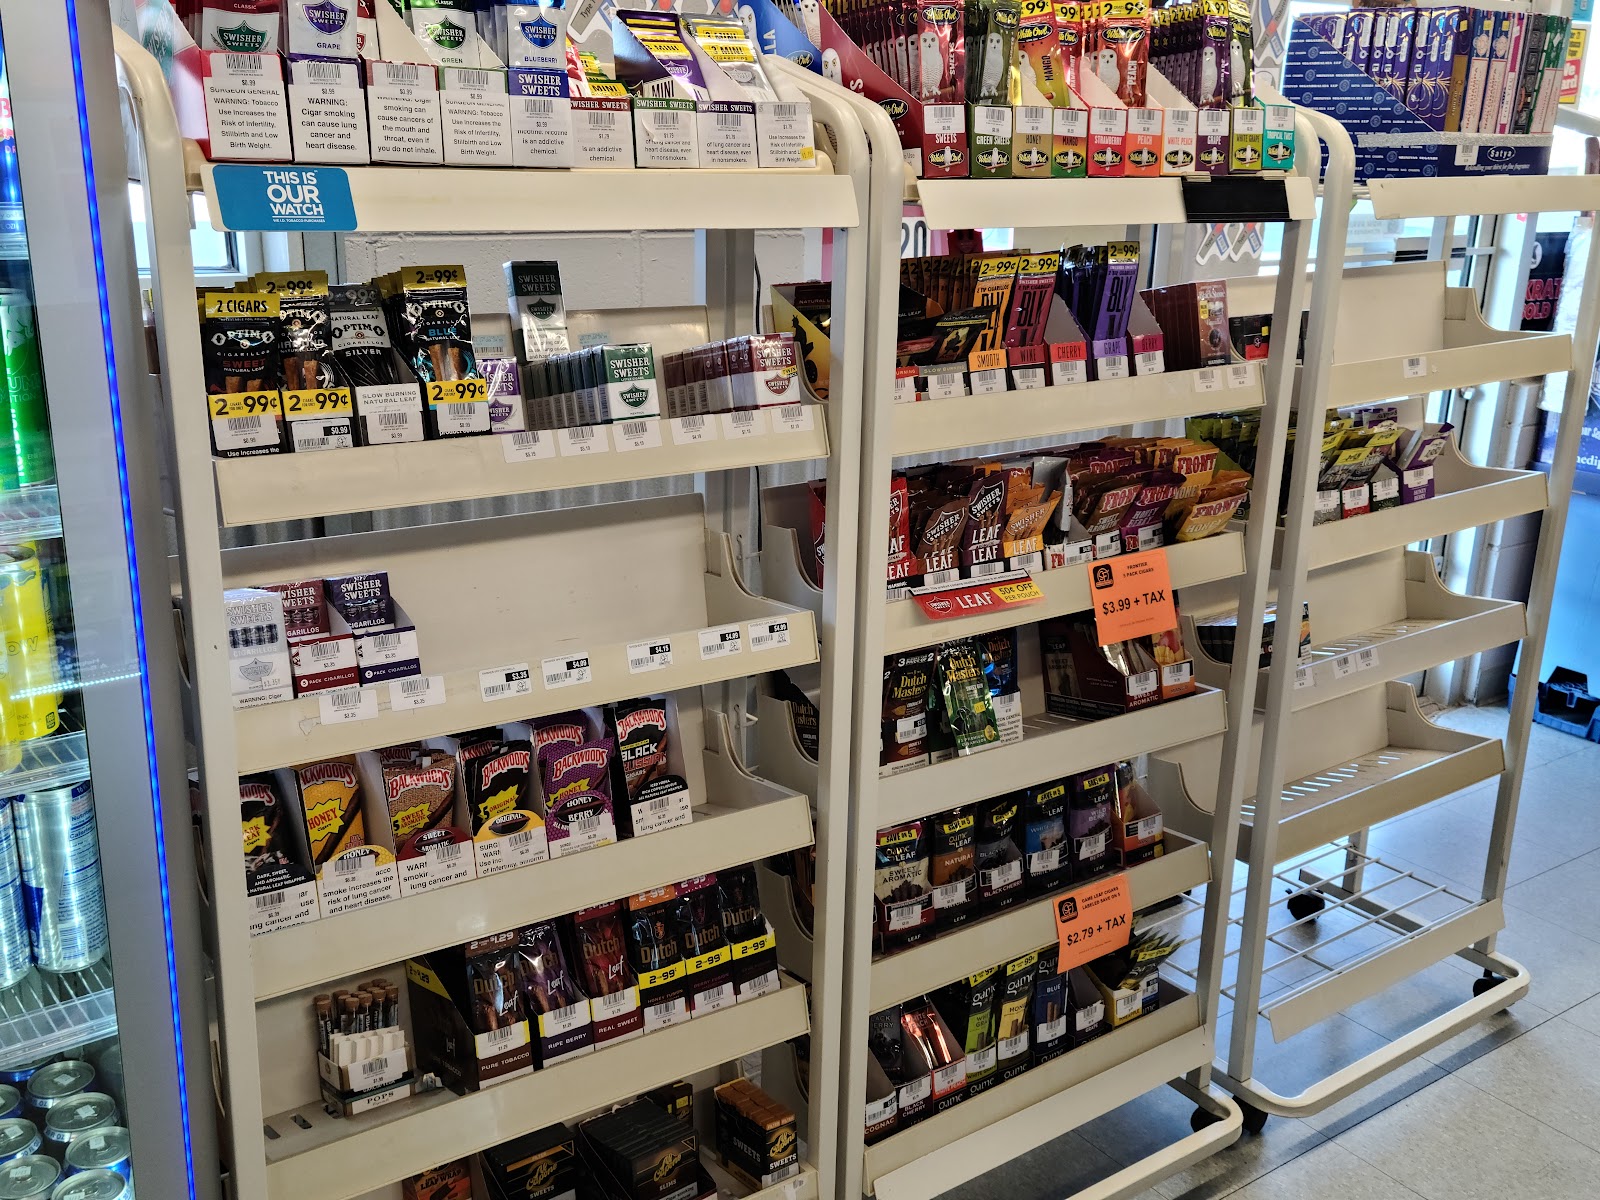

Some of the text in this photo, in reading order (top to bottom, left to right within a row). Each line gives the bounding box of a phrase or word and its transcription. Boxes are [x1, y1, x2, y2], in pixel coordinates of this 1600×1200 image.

[308, 11, 345, 20] SWISHER
[430, 27, 464, 36] SWISHER
[524, 25, 557, 36] SWISHER
[528, 32, 555, 40] SWEETS
[223, 32, 262, 42] SWISHER
[316, 42, 341, 50] GRAPE
[524, 55, 558, 63] BLUEBERRY
[1044, 56, 1053, 81] MANGO
[1128, 60, 1137, 85] PEACH
[518, 74, 561, 87] SWISHER
[522, 84, 561, 96] SWEETS
[591, 84, 618, 92] MINI
[651, 80, 674, 98] MINI
[214, 98, 249, 106] WARNING:
[308, 98, 348, 107] WARNING:
[636, 99, 694, 109] SWISHER SWEETS
[699, 103, 753, 112] SWISHER SWEETS
[301, 109, 355, 119] Cigar smoking
[341, 121, 357, 130] lung
[935, 133, 957, 143] SWEETS
[1026, 135, 1042, 144] HONEY
[1063, 137, 1078, 146] MANGO
[1095, 135, 1122, 145] STRAWBERRY
[1138, 135, 1152, 145] PEACH
[327, 143, 357, 151] disease.
[1490, 147, 1512, 158] Satya
[263, 171, 317, 185] THIS IS
[267, 185, 319, 203] OUR
[270, 203, 324, 216] WATCH
[518, 274, 556, 284] SWISHER
[521, 282, 556, 292] SWEETS
[217, 300, 268, 312] 2 CIGARS
[332, 323, 385, 338] OPTIMO
[429, 327, 457, 336] BLUE
[211, 330, 275, 345] OPTIMO
[1104, 341, 1121, 354] GRAPE
[1142, 339, 1158, 350] BERRY
[345, 348, 382, 357] SILVER
[756, 347, 792, 359] SWISHER
[1058, 344, 1081, 359] CHERRY
[223, 359, 266, 368] SWEET
[610, 357, 650, 368] SWISHER
[760, 356, 792, 367] SWEETS
[977, 354, 1000, 368] SMOOTH
[614, 366, 649, 377] SWEETS
[215, 395, 277, 416] 2 99¢
[289, 392, 349, 412] 2 99¢
[364, 397, 397, 405] NATURAL
[331, 426, 348, 434] $0.99
[972, 488, 1001, 514] SWISHER
[926, 513, 960, 538] SWISHER
[972, 524, 1001, 544] LEAF
[1013, 538, 1037, 554] LEAF
[973, 546, 998, 563] LEAF
[926, 554, 953, 573] LEAF
[1127, 562, 1147, 570] FRONTIER
[341, 580, 382, 592] SWISHER
[999, 583, 1033, 595] 50¢ OFF
[344, 589, 381, 601] SWEETS
[956, 591, 993, 609] LEAF
[1018, 591, 1039, 599] POUCH
[1103, 598, 1130, 616] $3.99
[1143, 590, 1165, 605] TAX
[226, 603, 273, 616] SWISHER
[388, 664, 417, 674] CIGARILLOS
[949, 657, 976, 670] Dutch
[324, 673, 355, 682] CIGARILLOS
[512, 670, 528, 680] $3.35
[946, 667, 980, 682] Masters
[901, 675, 927, 688] Dutch
[892, 684, 927, 698] Masters
[1129, 695, 1159, 706] AROMATIC
[618, 708, 666, 740] BACKWOODS
[481, 751, 530, 790] BACKWOODS
[553, 748, 608, 781] BACKWOODS
[389, 769, 451, 798] BACKWOODS
[559, 785, 582, 799] HONEY
[566, 797, 593, 808] HONEY
[1094, 793, 1109, 804] LEAF
[401, 809, 425, 822] SWEET
[568, 809, 594, 822] BERRY
[1048, 805, 1064, 816] LEAF
[308, 808, 338, 830] HONEY
[955, 836, 972, 848] LEAF
[895, 851, 916, 861] LEAF
[945, 853, 974, 866] NATURAL
[882, 870, 922, 883] AROMATIC
[889, 866, 917, 876] SWEET
[410, 870, 467, 890] lung cancer and
[349, 882, 381, 894] increases
[1104, 886, 1119, 894] CIGARS
[328, 898, 341, 906] risk
[352, 891, 367, 901] lung
[369, 885, 391, 895] cancer
[344, 901, 363, 911] heart
[364, 895, 392, 906] disease.
[1067, 927, 1093, 946] $2.79
[1105, 914, 1126, 930] TAX
[907, 934, 921, 942] LEAF
[608, 955, 624, 980] Leaf
[1046, 983, 1061, 993] BLUE
[598, 1016, 638, 1034] REAL SWEET
[548, 1032, 587, 1049] RIPE BERRY
[1047, 1039, 1059, 1048] BLUE
[481, 1052, 530, 1071] PURE TOBACCO
[1004, 1062, 1028, 1081] game
[970, 1077, 994, 1098] game
[367, 1092, 394, 1104] POPS
[938, 1092, 963, 1110] game
[902, 1103, 925, 1117] CHERRY
[864, 1117, 895, 1135] COGNAC
[769, 1153, 798, 1171] SWEETS
[420, 1169, 462, 1190] LEAF WRAP
[530, 1185, 554, 1199] SWEETS
